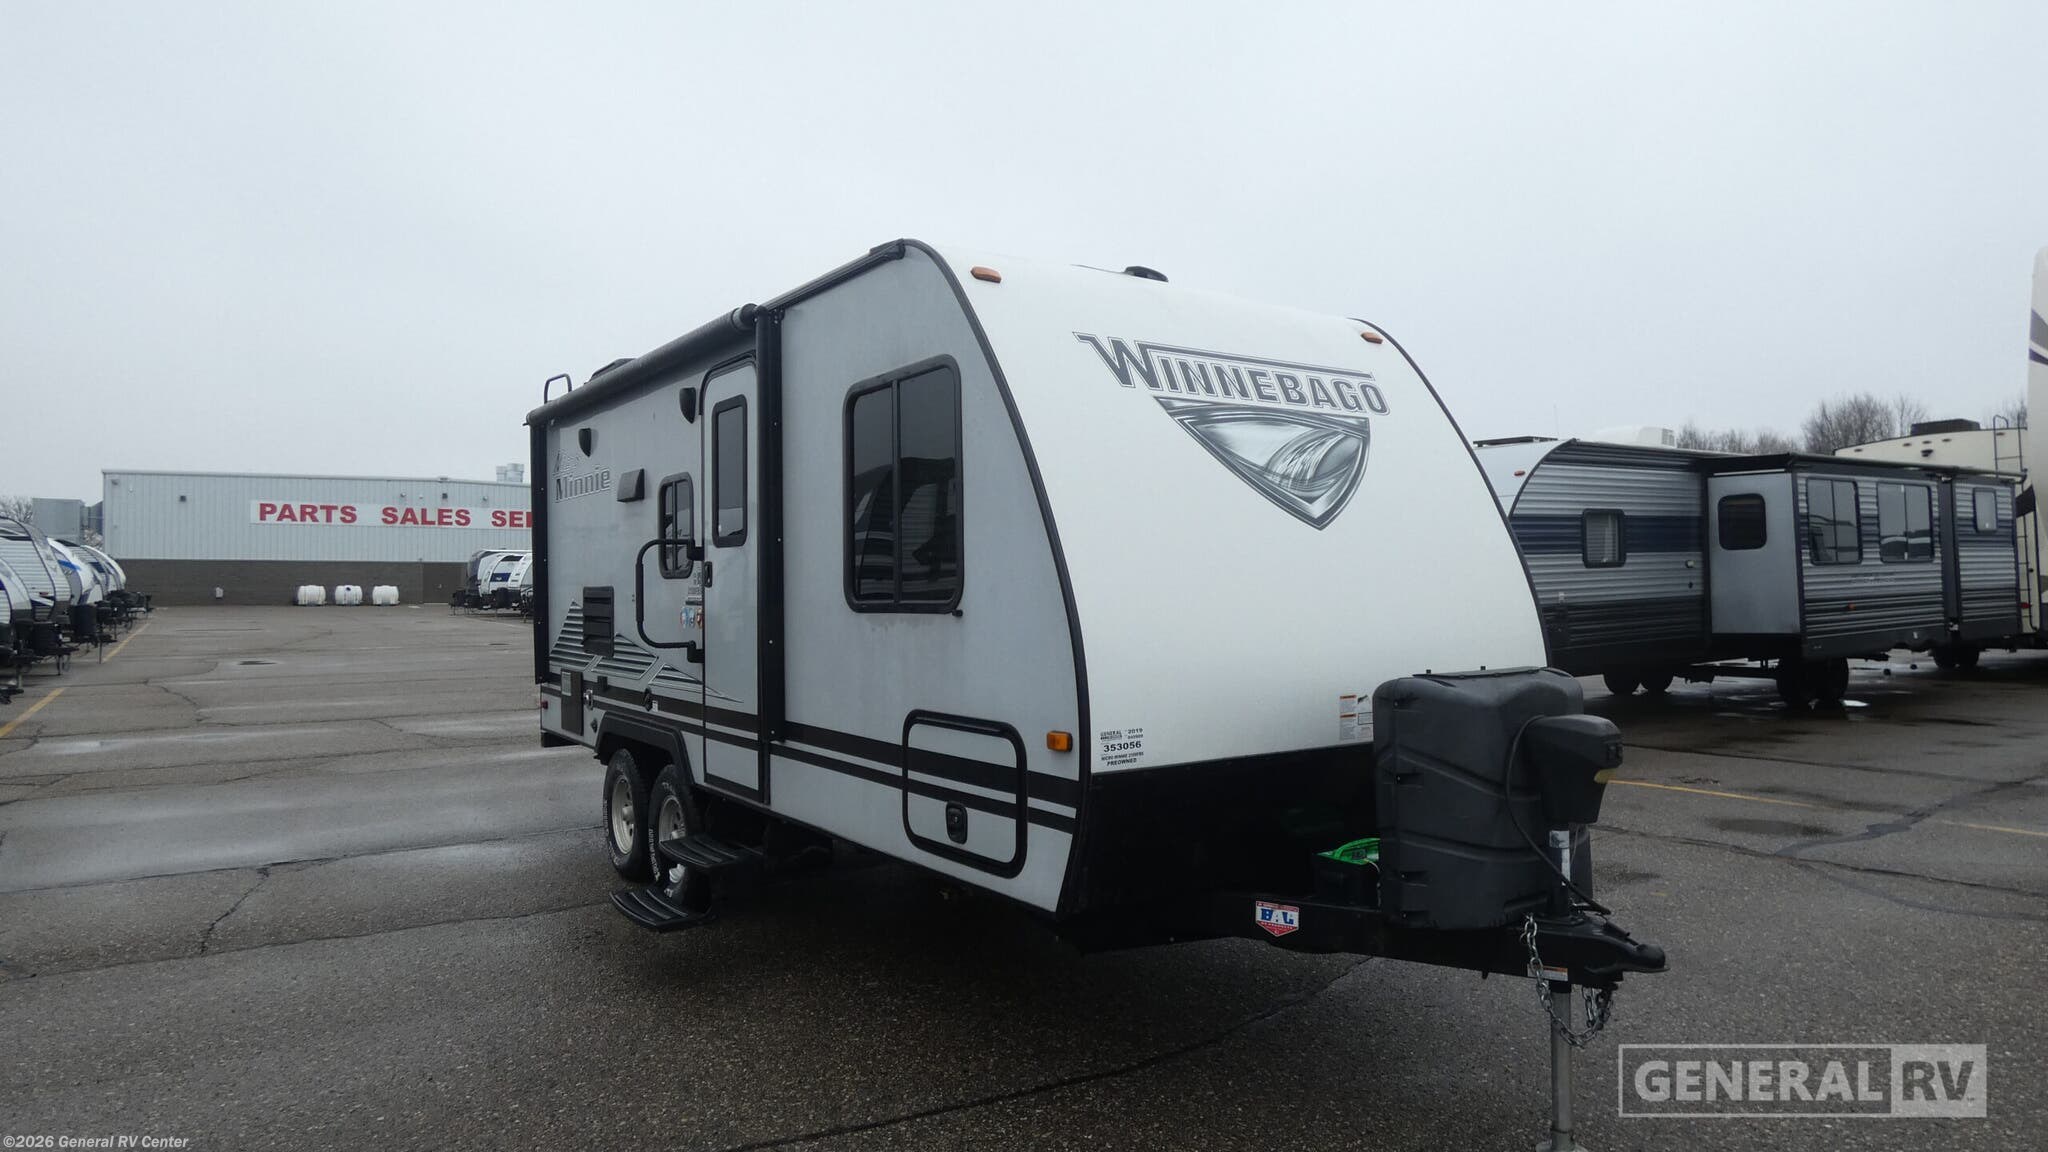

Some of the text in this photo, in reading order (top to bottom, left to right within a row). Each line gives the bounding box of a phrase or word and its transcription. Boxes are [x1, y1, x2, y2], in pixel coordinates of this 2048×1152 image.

[1072, 331, 1390, 416] WINNEBAGO
[555, 466, 610, 501] Minnie
[259, 503, 357, 524] PARTS
[381, 507, 471, 526] SALES
[1103, 741, 1142, 752] 353056
[1107, 758, 1137, 766] PREOWNED
